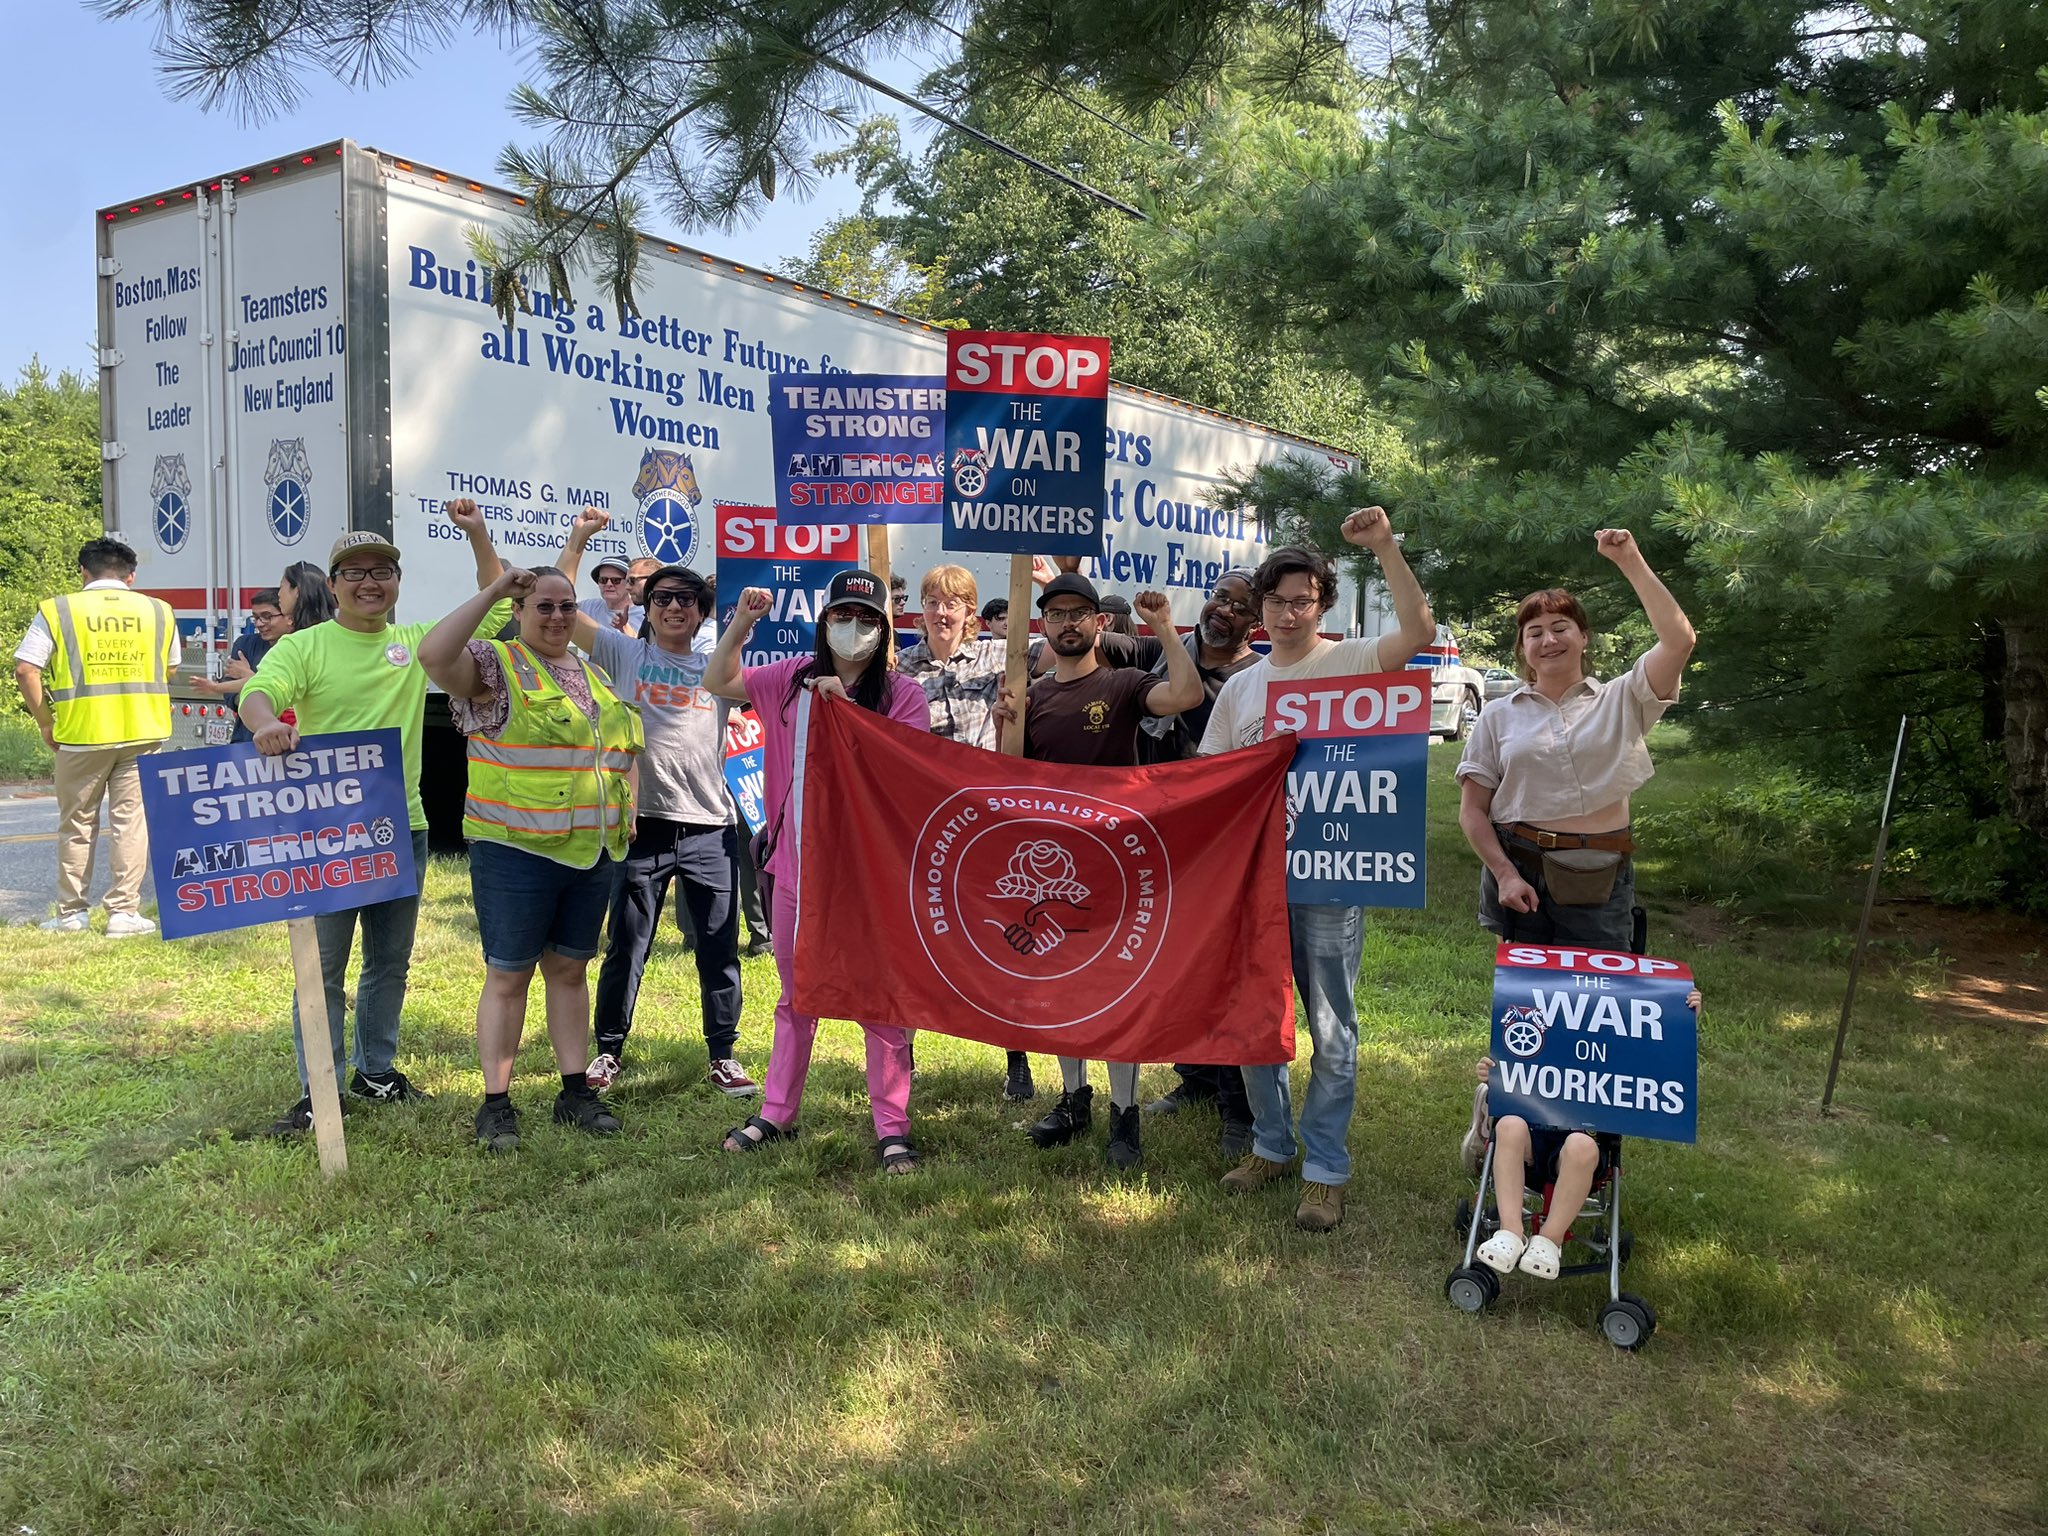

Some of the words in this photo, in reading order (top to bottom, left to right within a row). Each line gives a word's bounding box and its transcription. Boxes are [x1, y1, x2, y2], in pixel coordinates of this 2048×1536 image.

[241, 285, 327, 323] Teamsters
[409, 246, 577, 334] Builing
[587, 304, 605, 332] a
[619, 302, 712, 356] Better
[723, 329, 810, 374] Future
[146, 315, 187, 343] Follow
[228, 338, 265, 372] Joint
[269, 328, 322, 365] Council
[326, 324, 345, 355] 10
[156, 361, 179, 387] The
[481, 324, 530, 367] all
[542, 332, 686, 407] Working
[698, 367, 755, 412] Men
[956, 343, 1100, 389] STOP
[244, 385, 273, 413] New
[276, 372, 333, 413] England
[783, 387, 946, 411] TEAMSTER
[147, 402, 191, 431] Leader
[610, 397, 720, 450] Women
[806, 415, 931, 438] STRONG
[1010, 402, 1042, 422] THE
[976, 427, 1081, 472] WAR
[787, 453, 936, 478] AMERICA
[447, 471, 531, 500] THOMAS
[541, 484, 558, 503] G.
[567, 487, 610, 509] MARI
[643, 489, 690, 510] BROTHERHOOD
[790, 481, 944, 506] STRONGER
[1011, 478, 1037, 497] ON
[517, 509, 557, 526] JOINT
[620, 520, 633, 534] 10
[951, 501, 1095, 535] WORKERS
[1134, 479, 1245, 540] Council
[724, 516, 851, 554] STOP
[1089, 533, 1158, 584] New
[772, 565, 801, 582] THE
[846, 577, 875, 588] UNITE
[97, 639, 134, 648] EVERY
[777, 629, 799, 644] ON
[87, 651, 146, 661] MOMENT
[91, 667, 142, 677] MATTERS
[639, 663, 702, 686] UNIO
[634, 679, 691, 708] YES
[1273, 685, 1422, 731] STOP
[208, 725, 225, 739] 9469
[741, 755, 757, 769] THE
[1324, 744, 1357, 762] THE
[158, 744, 384, 796] TEAMSTER
[193, 778, 363, 825] STRONG
[1287, 769, 1398, 814] WAR
[987, 797, 1121, 831] SOCIALISTS
[1123, 834, 1147, 857] OF
[1322, 822, 1349, 842] ON
[172, 822, 374, 879] AMERICA
[928, 807, 979, 935] DEMOCRATIC
[1286, 850, 1416, 883] ORKERS
[177, 851, 398, 912] STRONGER
[1117, 868, 1154, 962] AMERICA
[1507, 947, 1680, 974] STOP
[1572, 974, 1611, 990] THE
[1532, 988, 1663, 1041] WAR
[1575, 1040, 1607, 1063] ON
[1499, 1060, 1685, 1115] WORKERS
